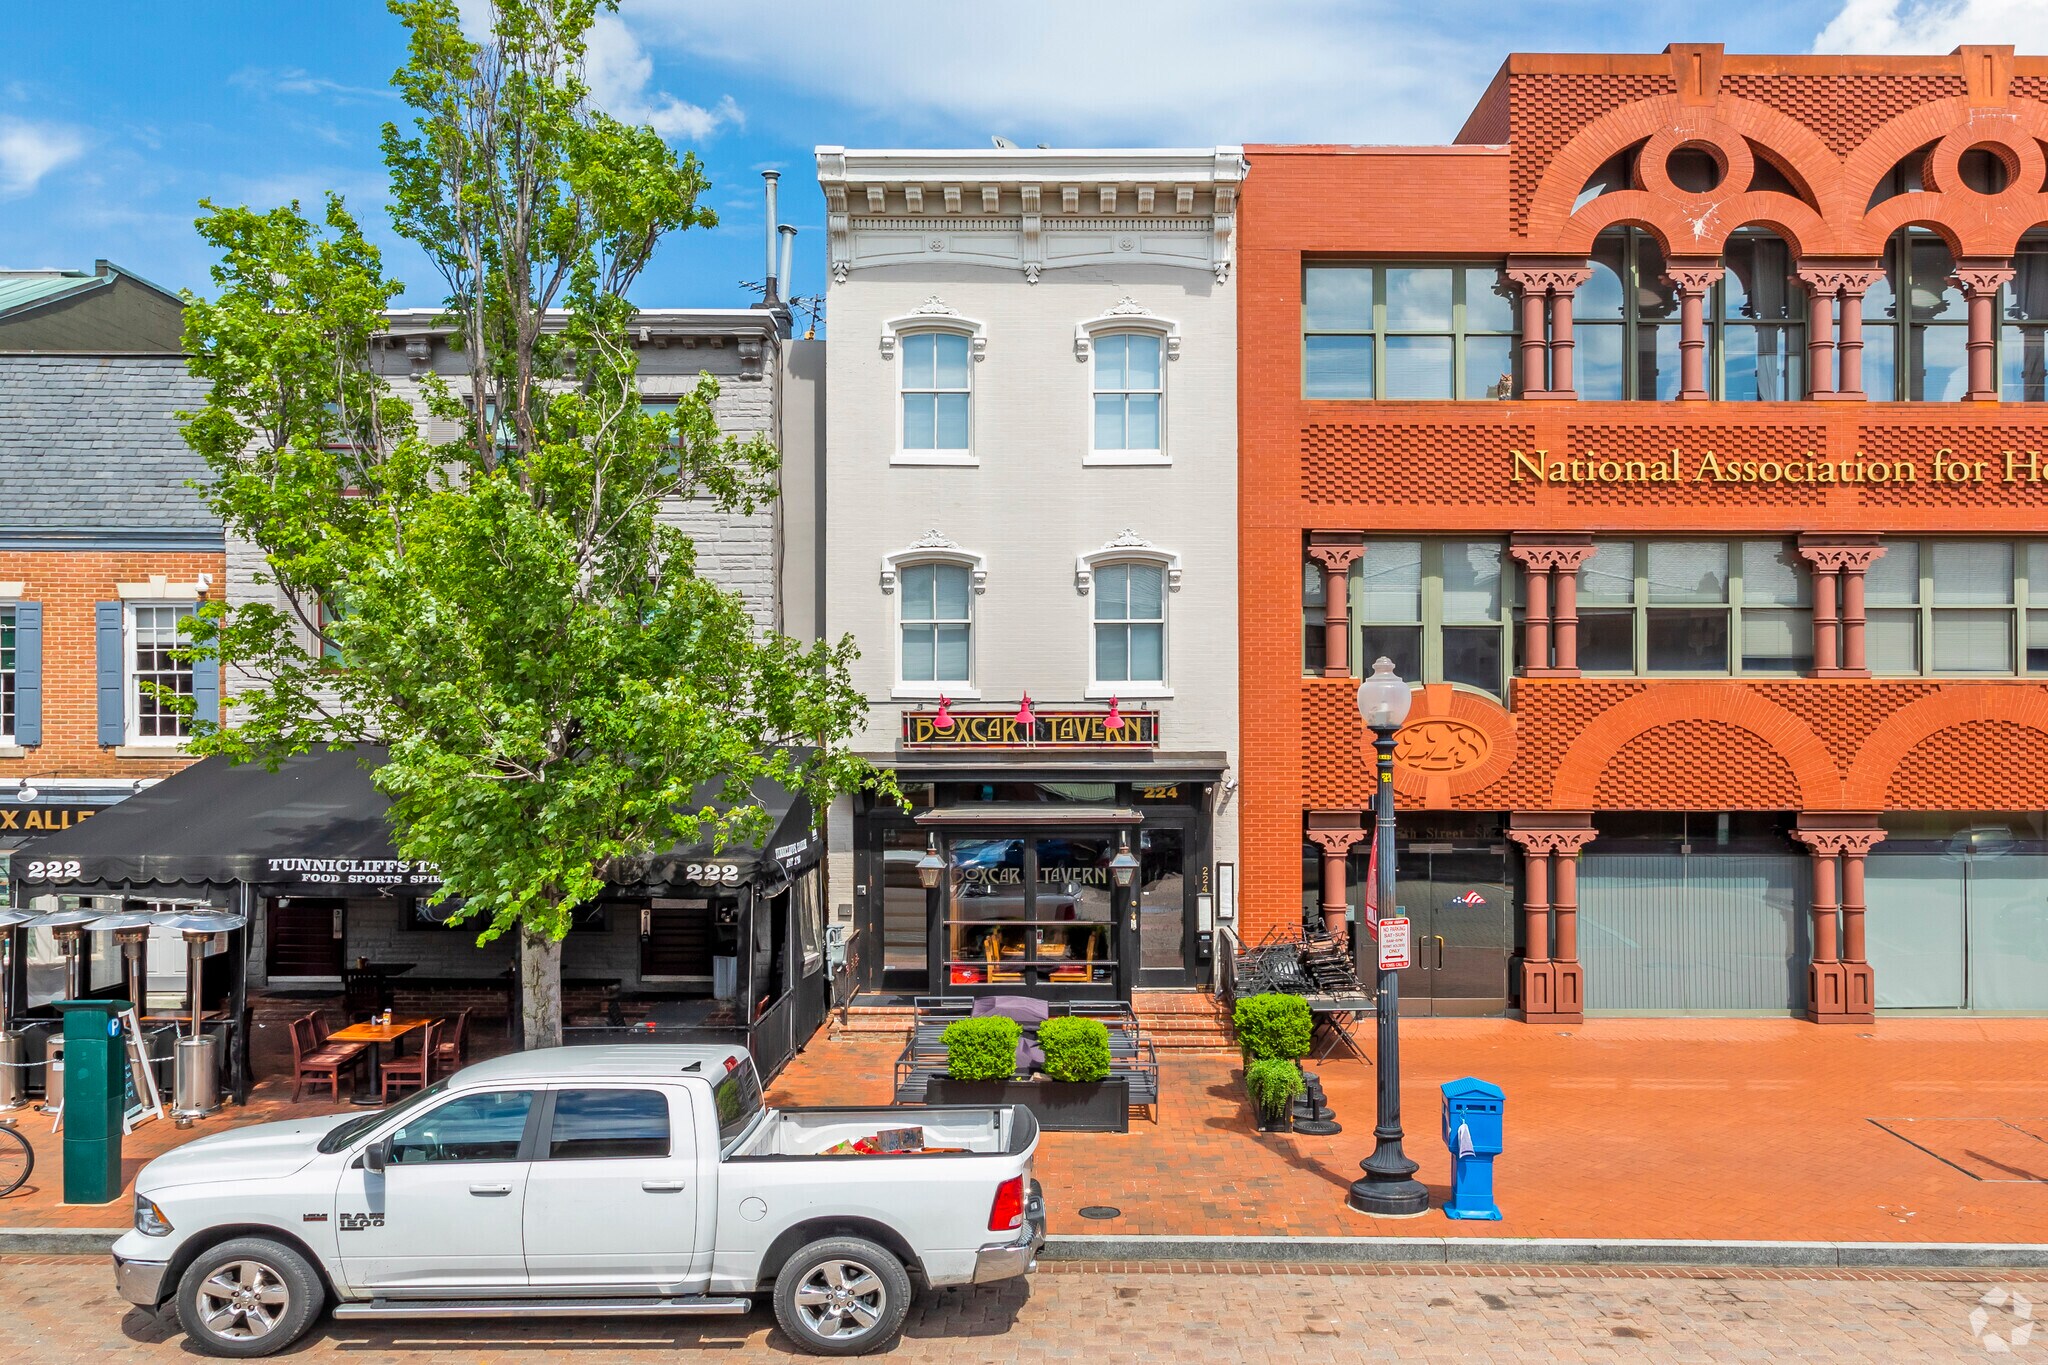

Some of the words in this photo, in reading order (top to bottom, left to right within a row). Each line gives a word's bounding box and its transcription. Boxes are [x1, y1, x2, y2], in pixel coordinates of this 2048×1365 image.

[1509, 448, 1682, 482] National
[1692, 450, 1918, 482] Association
[1932, 448, 1989, 482] for
[2003, 450, 2048, 482] H
[916, 718, 1020, 742] BOXCAR
[1044, 717, 1142, 742] TAVERN
[1143, 786, 1178, 799] 224
[1426, 827, 1464, 839] Street
[28, 860, 81, 878] 222
[268, 858, 410, 873] TUNNICLIFFS
[686, 863, 739, 881] 222
[301, 873, 341, 883] FOOD
[347, 875, 403, 884] SPORTS
[950, 867, 1021, 885] BOXCAR
[1040, 867, 1107, 885] TAVERN
